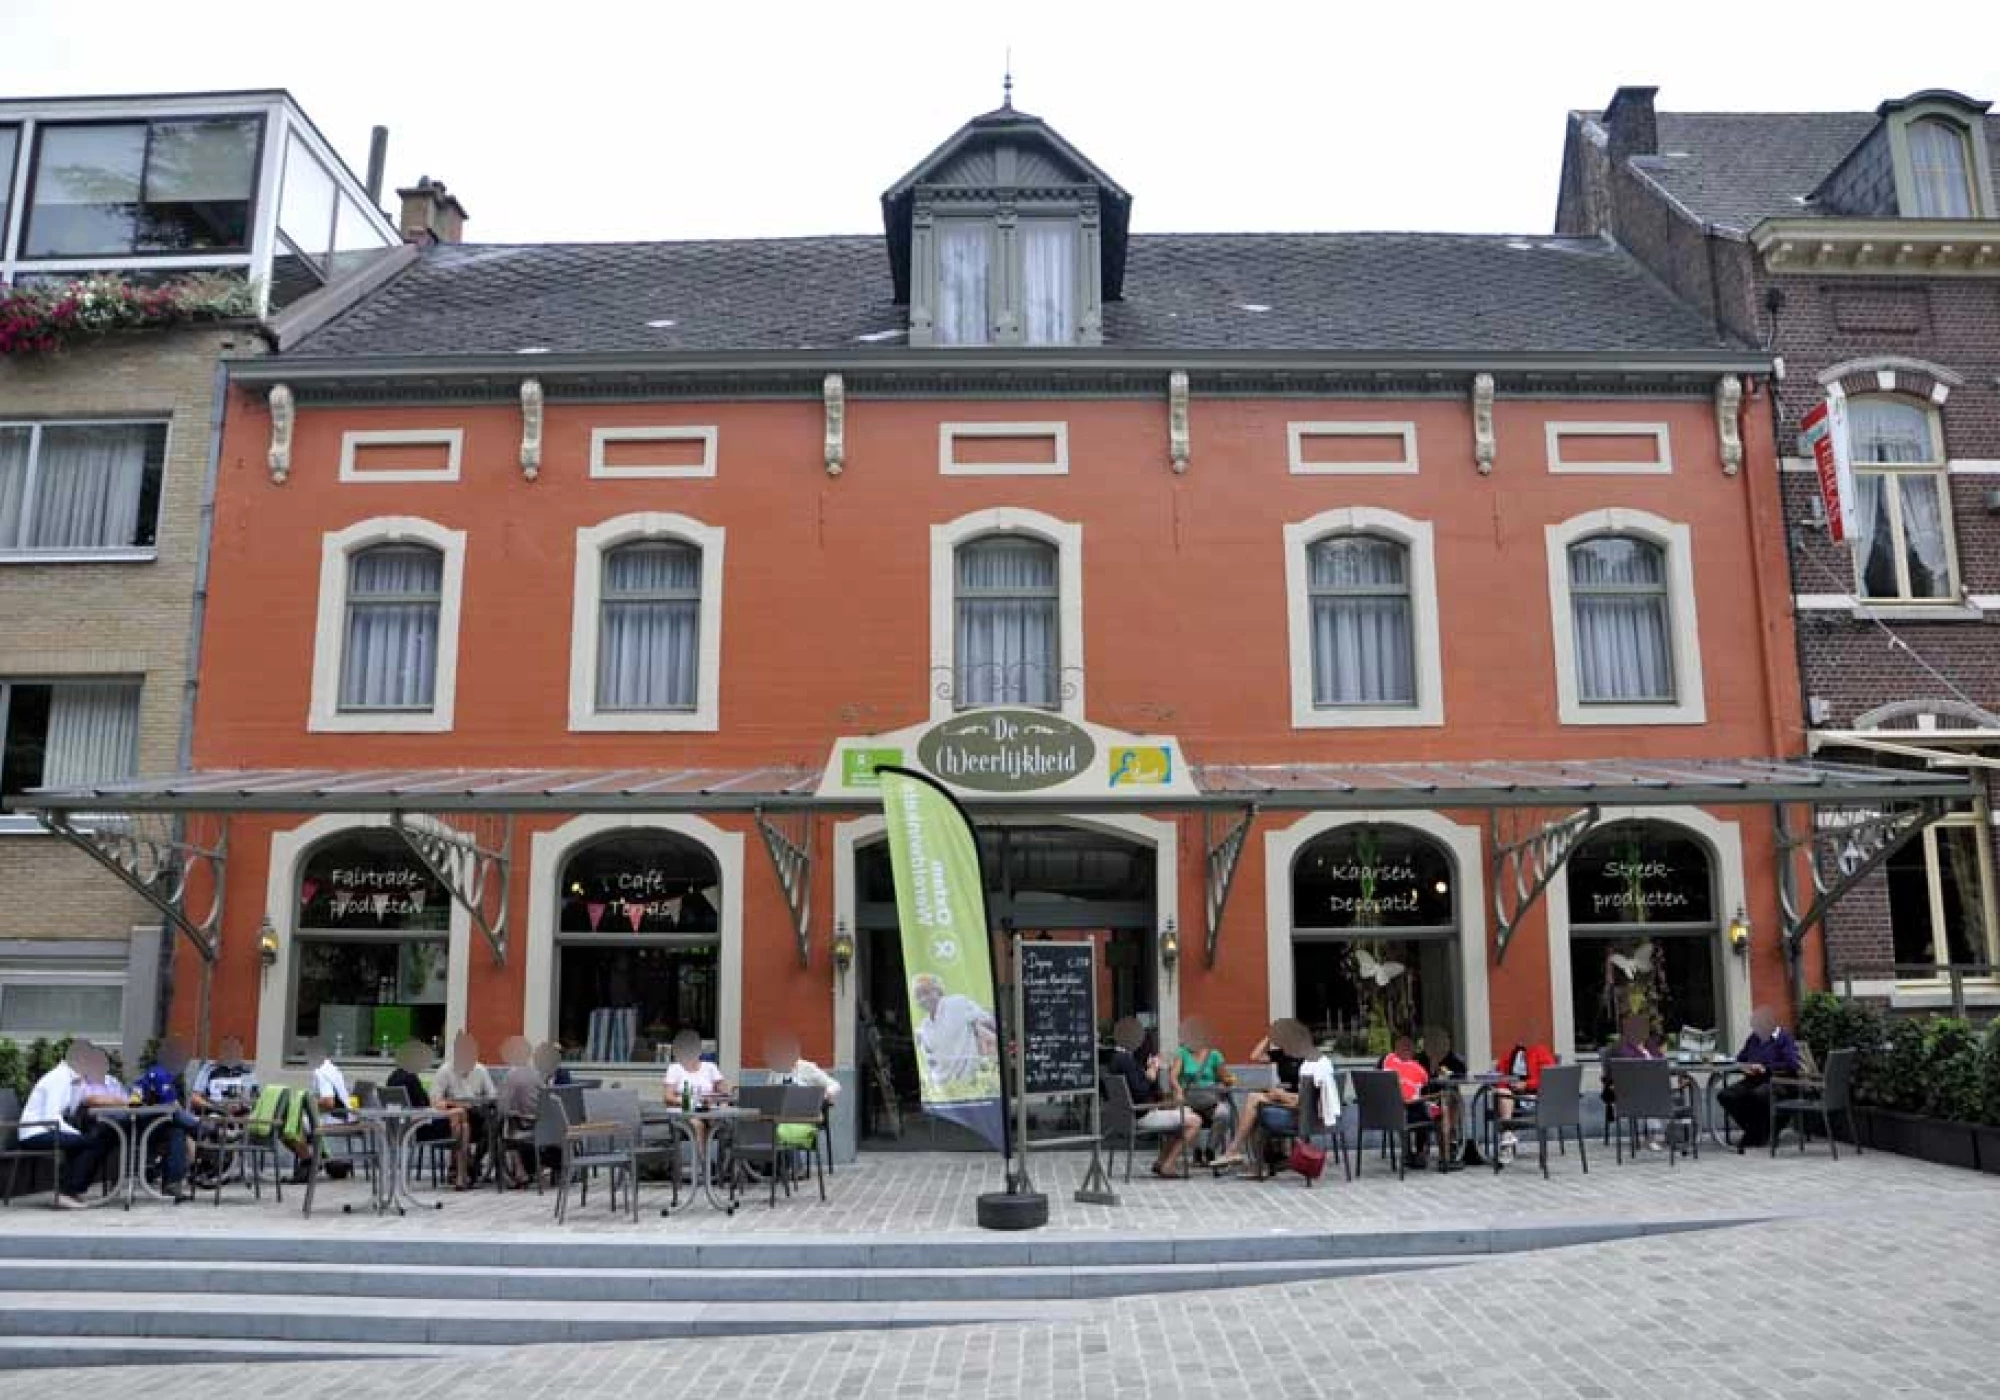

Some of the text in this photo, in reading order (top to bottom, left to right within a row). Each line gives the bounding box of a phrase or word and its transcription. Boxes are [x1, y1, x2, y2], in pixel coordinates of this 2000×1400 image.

[994, 717, 1018, 740] De
[935, 745, 1076, 780] (h)eerlijkheid
[1332, 865, 1415, 881] Kaarsen
[1591, 889, 1689, 914] producten
